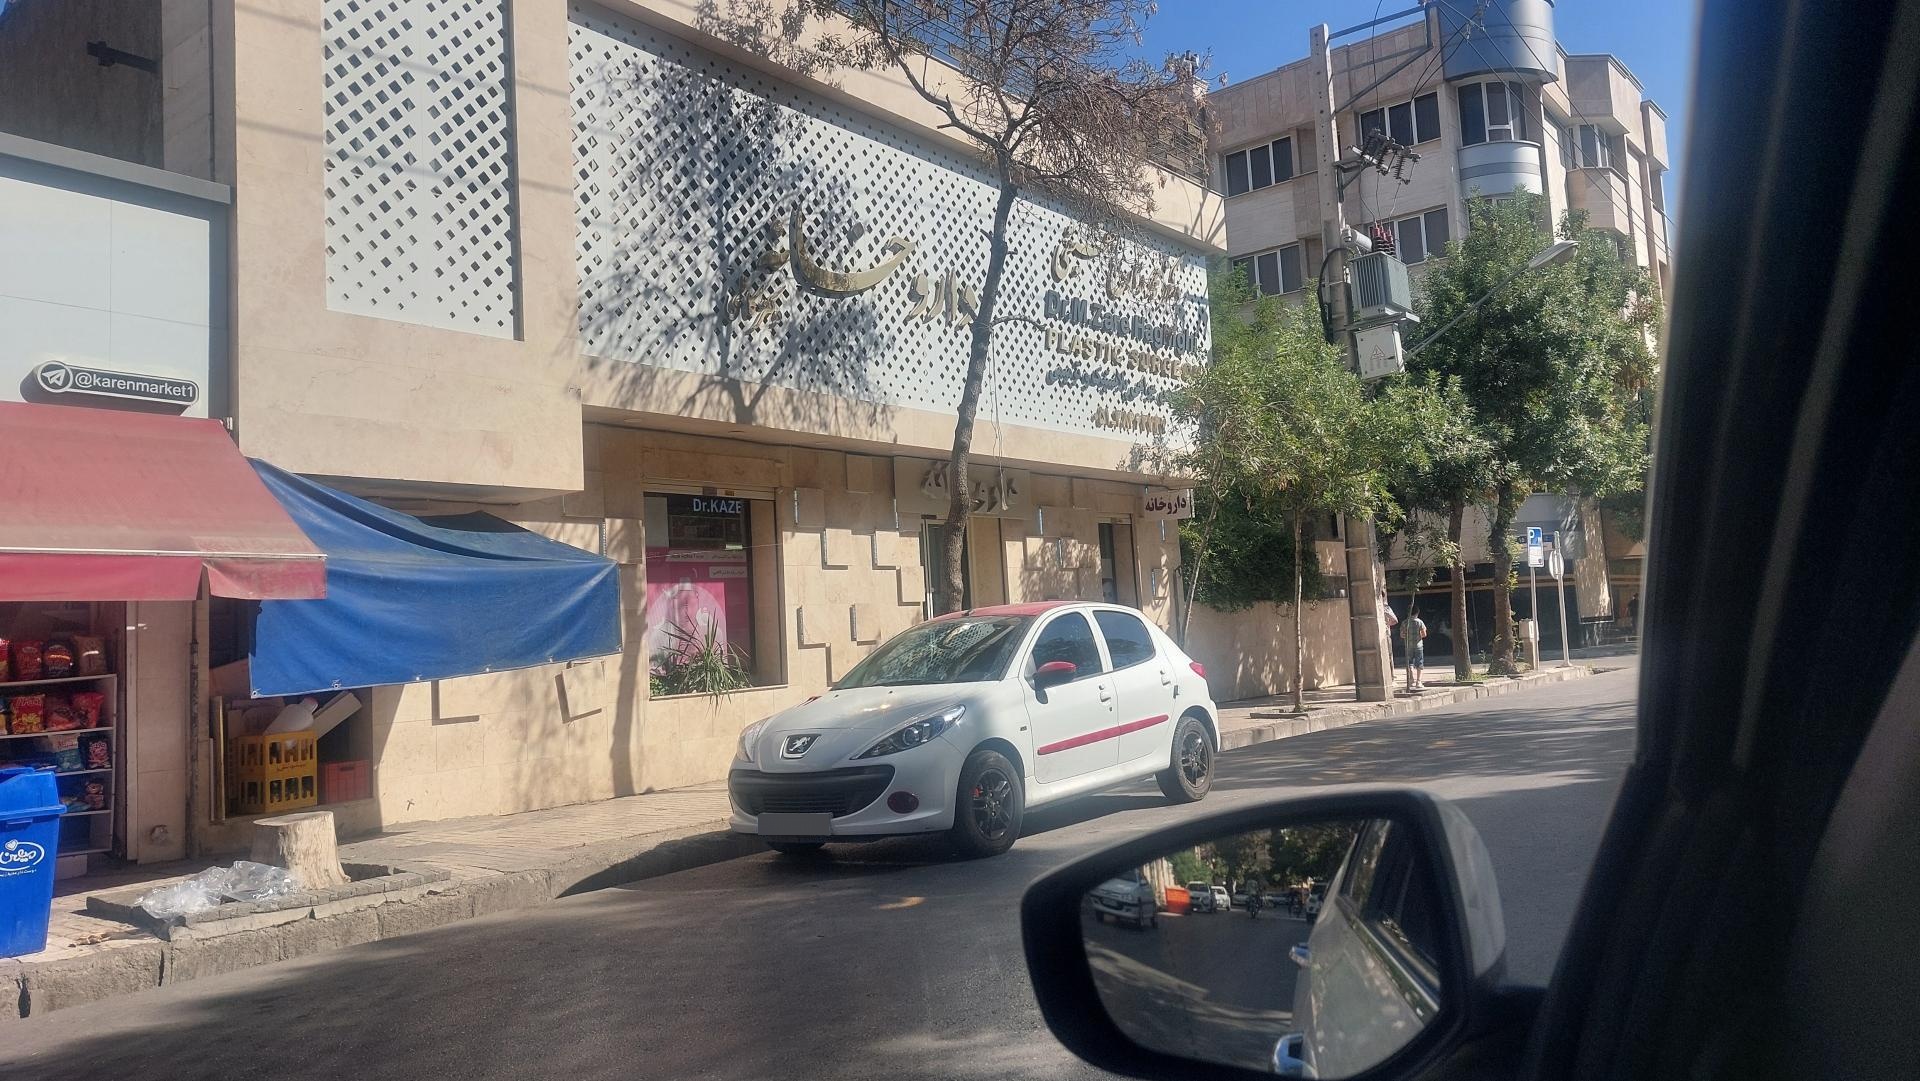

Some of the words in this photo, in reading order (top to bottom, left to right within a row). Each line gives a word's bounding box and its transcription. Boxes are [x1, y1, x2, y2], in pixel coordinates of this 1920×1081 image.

[1045, 328, 1126, 367] PLASTIC
[75, 372, 193, 397] @karenmarket1
[1145, 495, 1187, 515] داروخانه
